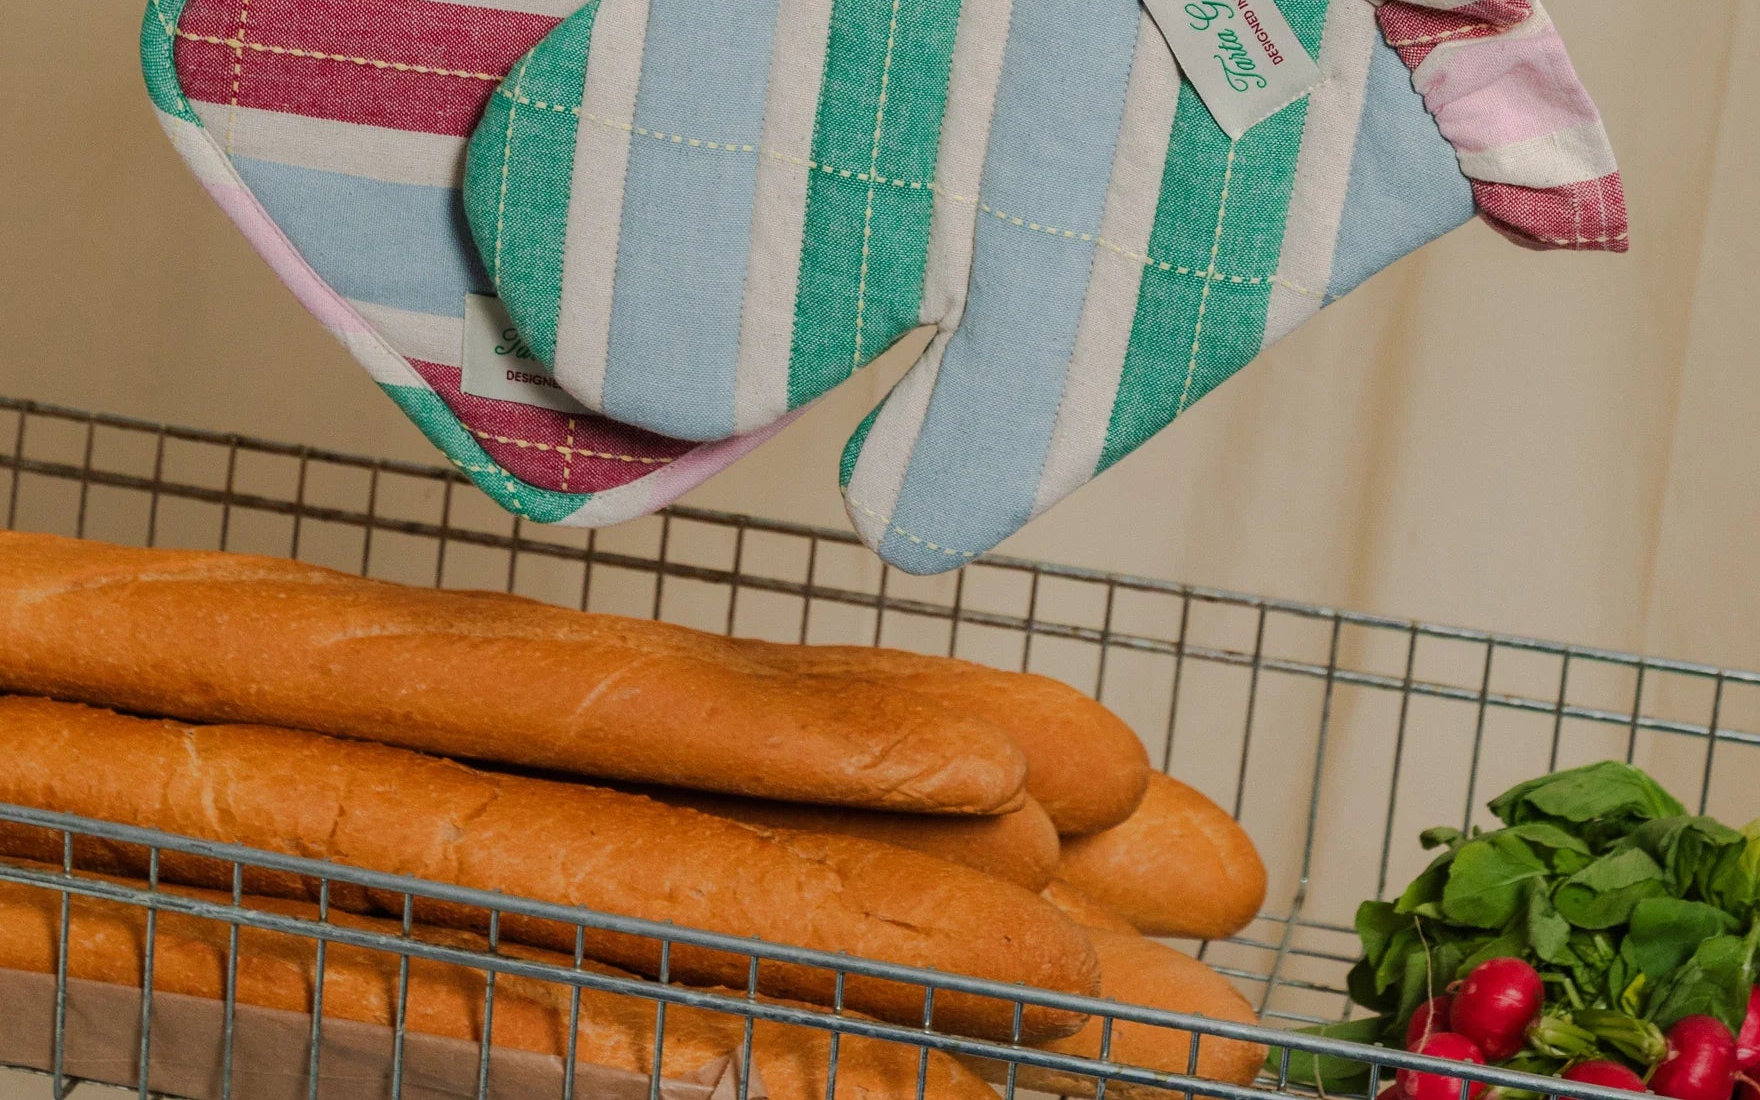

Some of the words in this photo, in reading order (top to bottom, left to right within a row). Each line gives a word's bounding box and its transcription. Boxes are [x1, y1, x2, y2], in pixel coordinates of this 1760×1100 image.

[1244, 10, 1284, 65] DESIGNED
[1214, 28, 1267, 92] Tarta
[494, 327, 537, 361] Ta
[506, 369, 563, 390] DESIGNE
